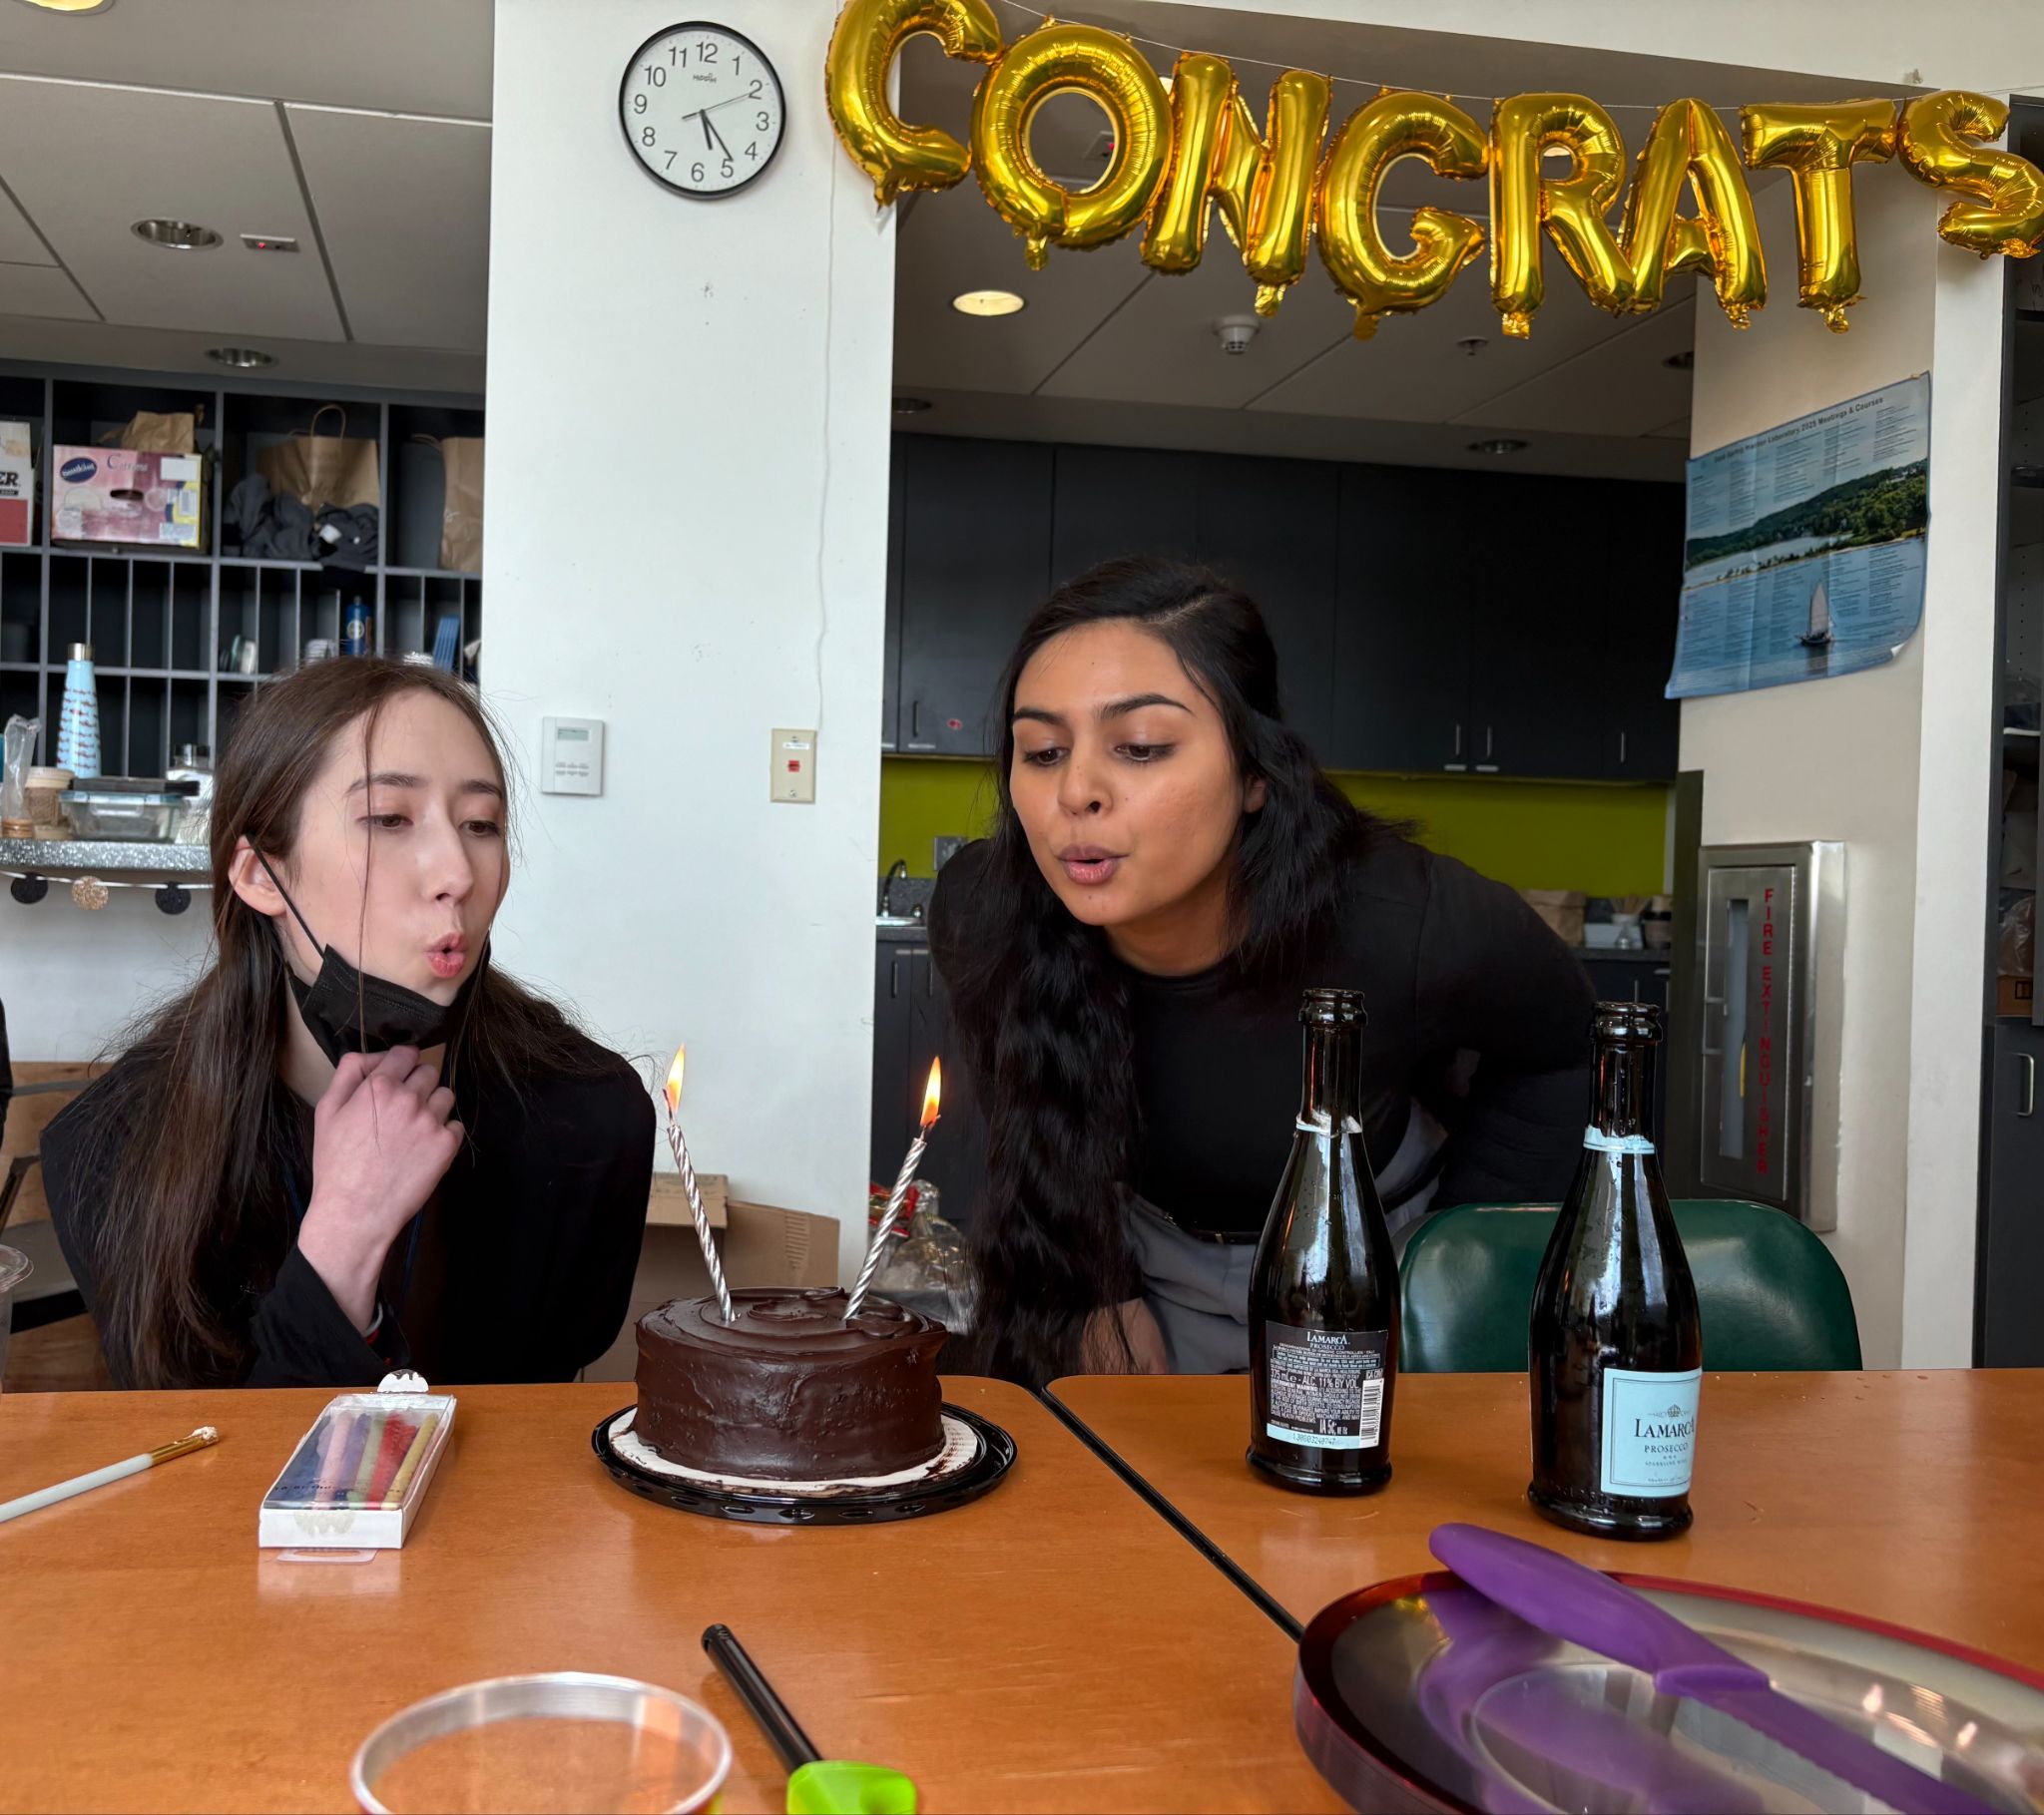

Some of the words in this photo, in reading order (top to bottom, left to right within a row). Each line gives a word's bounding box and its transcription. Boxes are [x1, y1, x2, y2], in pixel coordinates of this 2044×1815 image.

[669, 46, 688, 68] 11
[696, 41, 719, 64] 12
[644, 65, 667, 87] 10
[732, 55, 741, 76] 1
[748, 79, 763, 100] 2
[634, 94, 648, 115] 9
[756, 111, 769, 132] 3
[642, 126, 656, 148] 8
[664, 150, 678, 171] 7
[745, 141, 758, 162] 4
[691, 162, 705, 183] 6
[720, 158, 735, 179] 5
[825, 0, 2044, 335] CONGRATS
[1817, 409, 1847, 426] Meetings
[1854, 397, 1884, 412] Courses
[1762, 888, 1774, 956] FIRE
[1757, 965, 1773, 1175] EXTINGUISHER
[1309, 1342, 1345, 1351] PROSECCO
[1319, 1377, 1333, 1388] 11%
[1334, 1378, 1344, 1388] BY
[1644, 1442, 1689, 1454] PROSECCO
